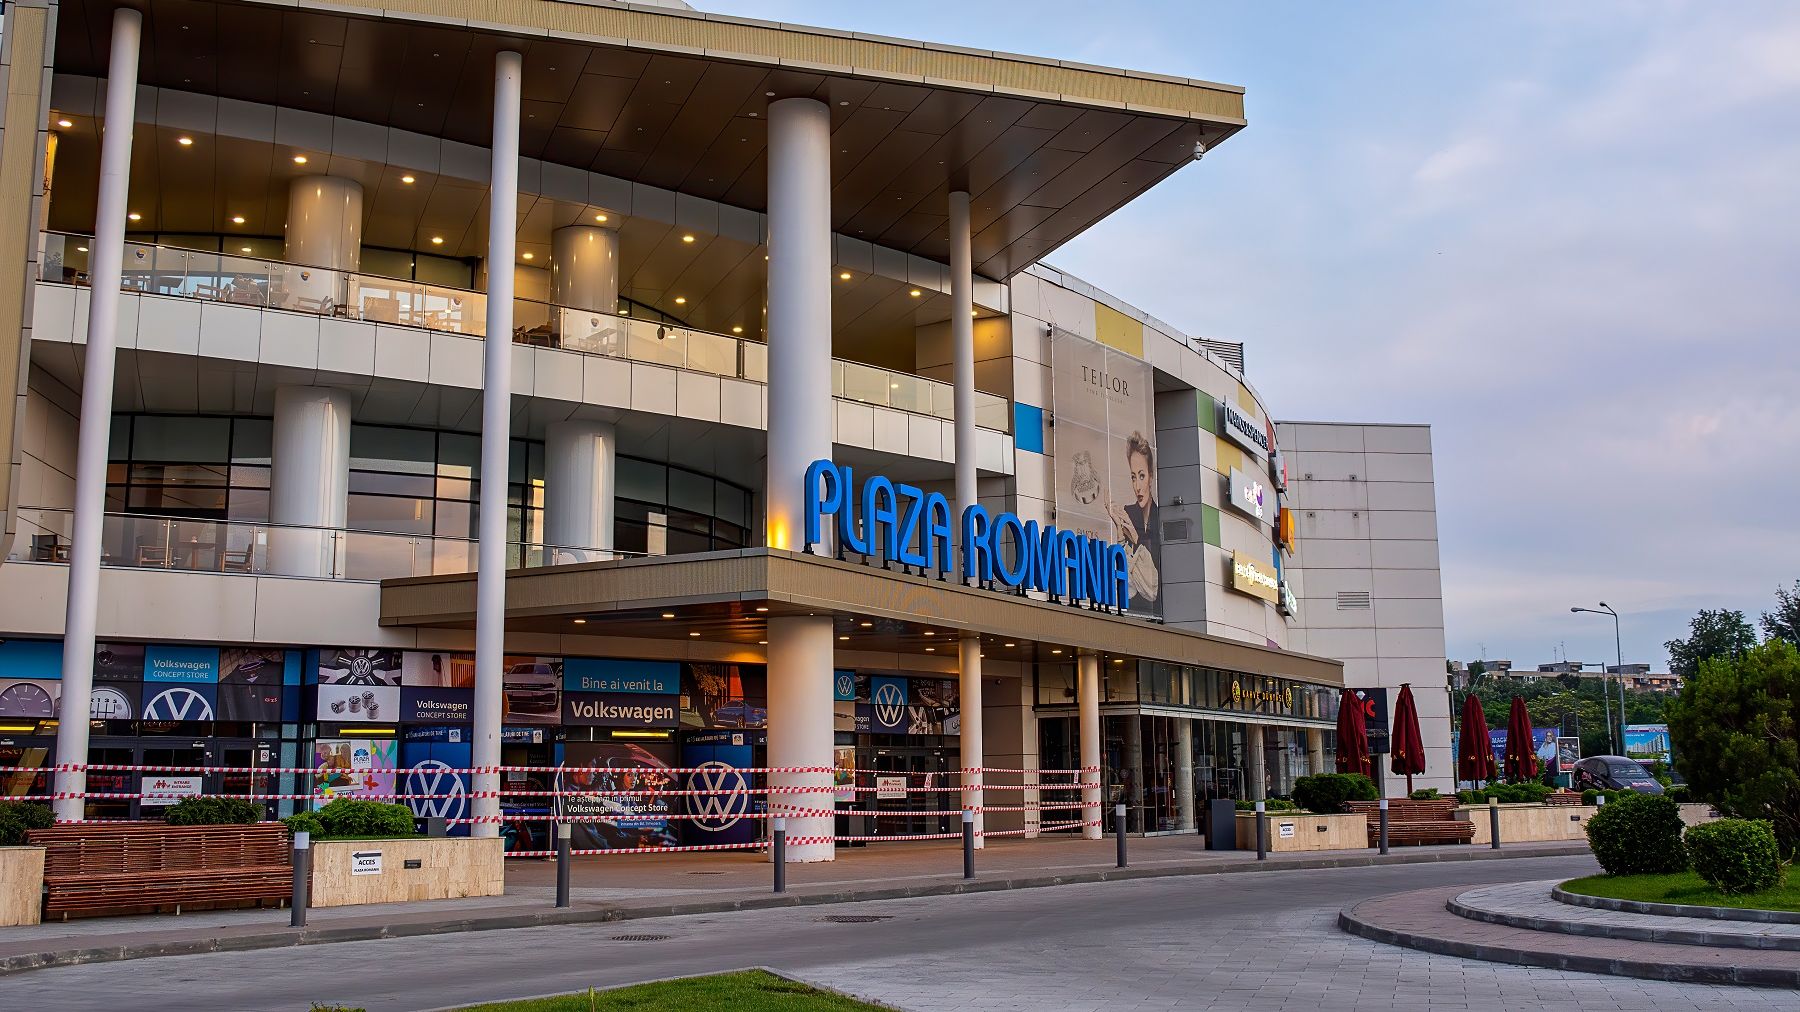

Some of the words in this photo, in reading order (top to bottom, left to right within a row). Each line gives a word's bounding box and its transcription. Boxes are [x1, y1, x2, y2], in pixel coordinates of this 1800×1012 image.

[1081, 365, 1130, 397] TEILOR
[803, 458, 953, 573] PLAZA
[961, 503, 1130, 610] ROMANIA
[153, 659, 211, 670] Volkswagen
[152, 670, 186, 679] CONCEPT
[186, 671, 209, 679] STORE
[581, 676, 608, 690] Bine
[610, 678, 621, 690] ai
[622, 679, 651, 691] venit
[653, 679, 664, 691] la
[416, 700, 468, 712] Volkswagen
[570, 700, 675, 724] Volkswagen
[416, 711, 446, 719] CONCEPT
[567, 795, 576, 803] Te
[619, 794, 643, 804] primul
[566, 804, 614, 815] Volkswagen
[648, 803, 668, 812] Store
